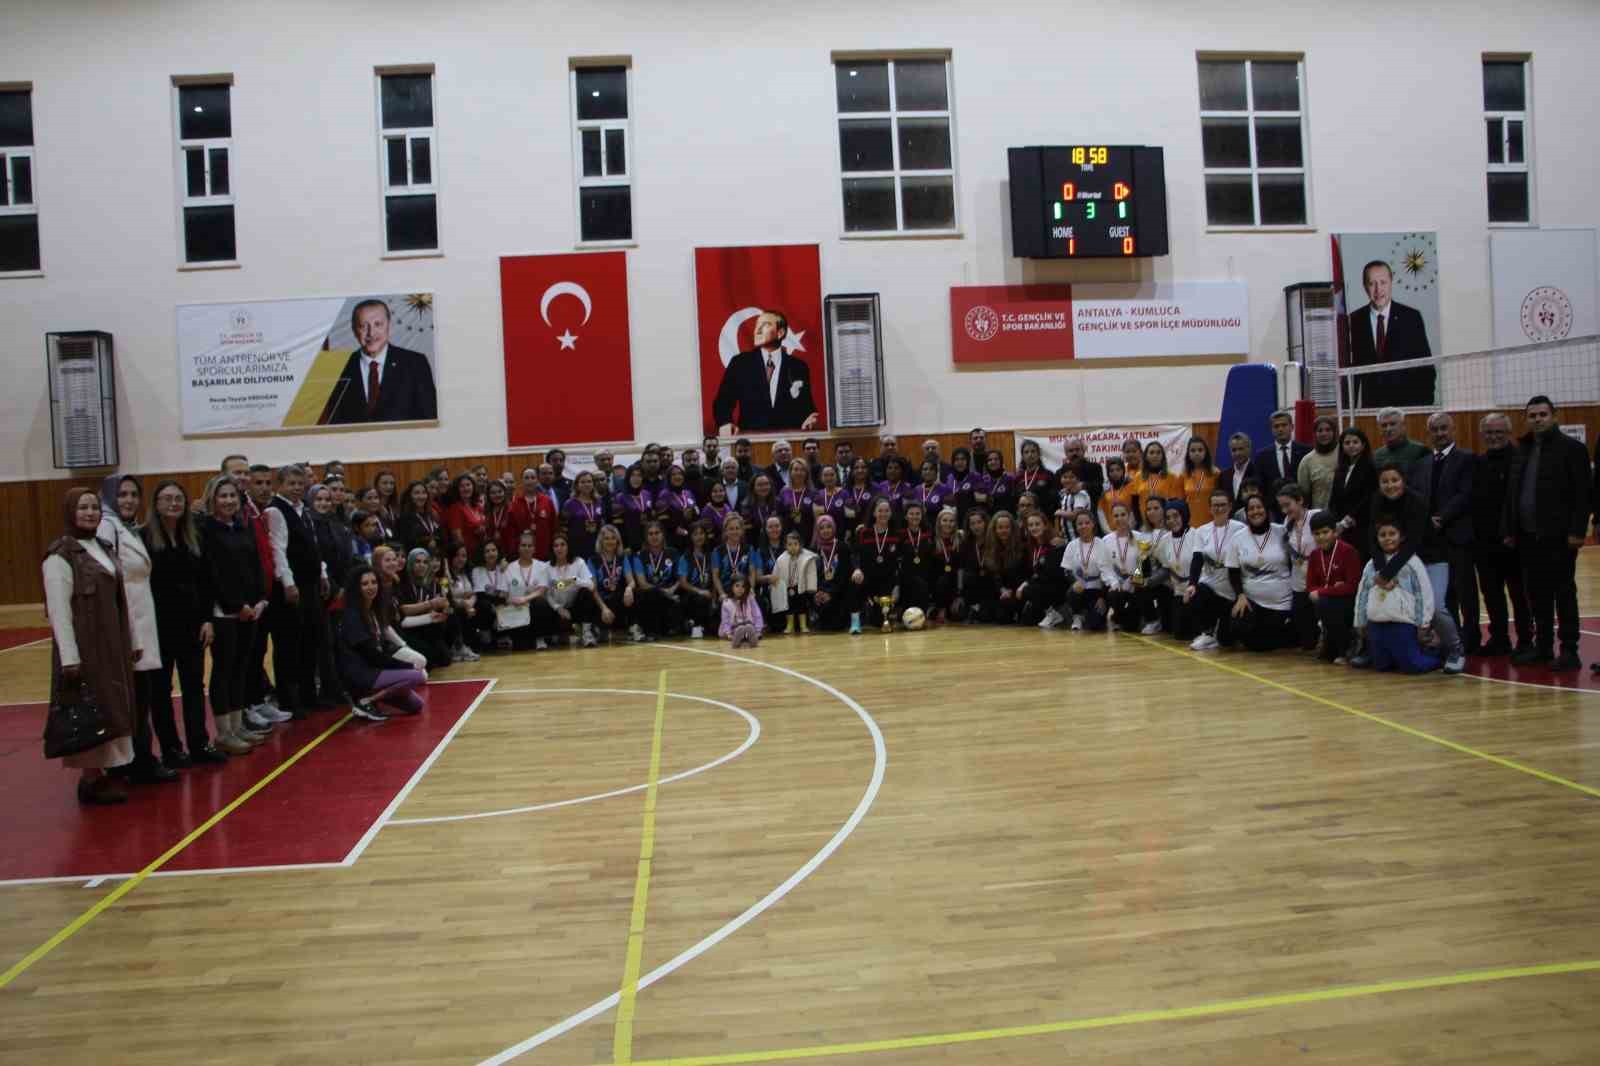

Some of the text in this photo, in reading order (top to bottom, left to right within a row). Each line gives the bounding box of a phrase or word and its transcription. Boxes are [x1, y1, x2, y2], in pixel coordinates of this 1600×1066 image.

[1063, 183, 1074, 200] 0
[1114, 183, 1123, 200] 0
[1086, 202, 1095, 219] 3
[1052, 226, 1073, 238] HOME
[1109, 225, 1130, 238] GUEST
[1069, 239, 1074, 255] 1
[1123, 238, 1133, 254] 0
[1018, 311, 1052, 322] GENÇLİK
[1054, 311, 1065, 321] VE
[1078, 307, 1122, 317] ANTALYA
[1131, 306, 1181, 316] KUMLUCA
[1002, 323, 1023, 331] SPOR
[1078, 316, 1241, 332] GENÇLİK VE SPOR İLÇE MÜDÜRLÜĞÜ
[197, 362, 289, 376] SPORCULARIMIZA
[192, 374, 295, 388] BAŞARILAR DİLİYORUM
[1122, 431, 1159, 440] KATILAN
